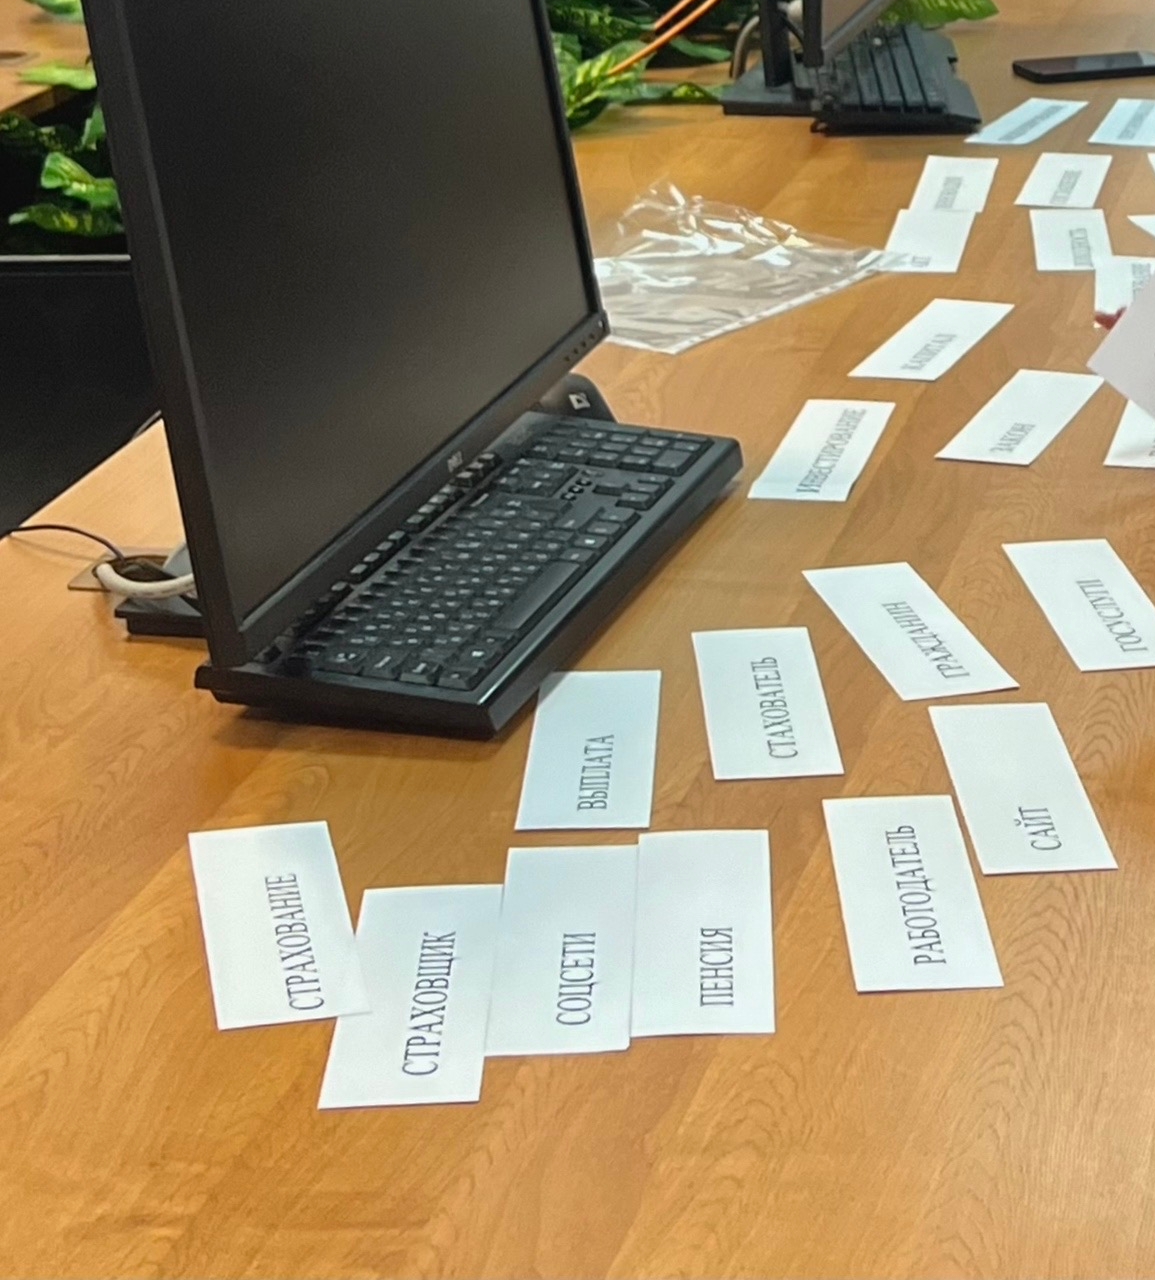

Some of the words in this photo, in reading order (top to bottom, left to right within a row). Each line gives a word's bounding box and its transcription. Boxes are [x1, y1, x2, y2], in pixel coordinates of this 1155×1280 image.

[902, 333, 958, 373] КАПИТАЛ
[795, 407, 867, 494] ИНВЕСТИРОВАНИЕ
[990, 422, 1035, 456] ЗАКОН
[882, 601, 971, 680] ГРАЖДАНИН
[1075, 577, 1149, 653] ГОСУСЛУГИ
[751, 657, 798, 758] СТАХОВАТЕЛЬ
[577, 735, 614, 811] ВЫПЛАТА
[1014, 807, 1062, 850] САЙТ
[886, 824, 947, 966] РАБОТОДАТЕЛЬ
[265, 872, 323, 1011] СТРАХОВАНИЕ
[556, 933, 598, 1025] СОЦСЕТИ
[700, 927, 734, 1007] ПЕНСИЯ
[402, 931, 457, 1075] СТРАХОВЩИК
